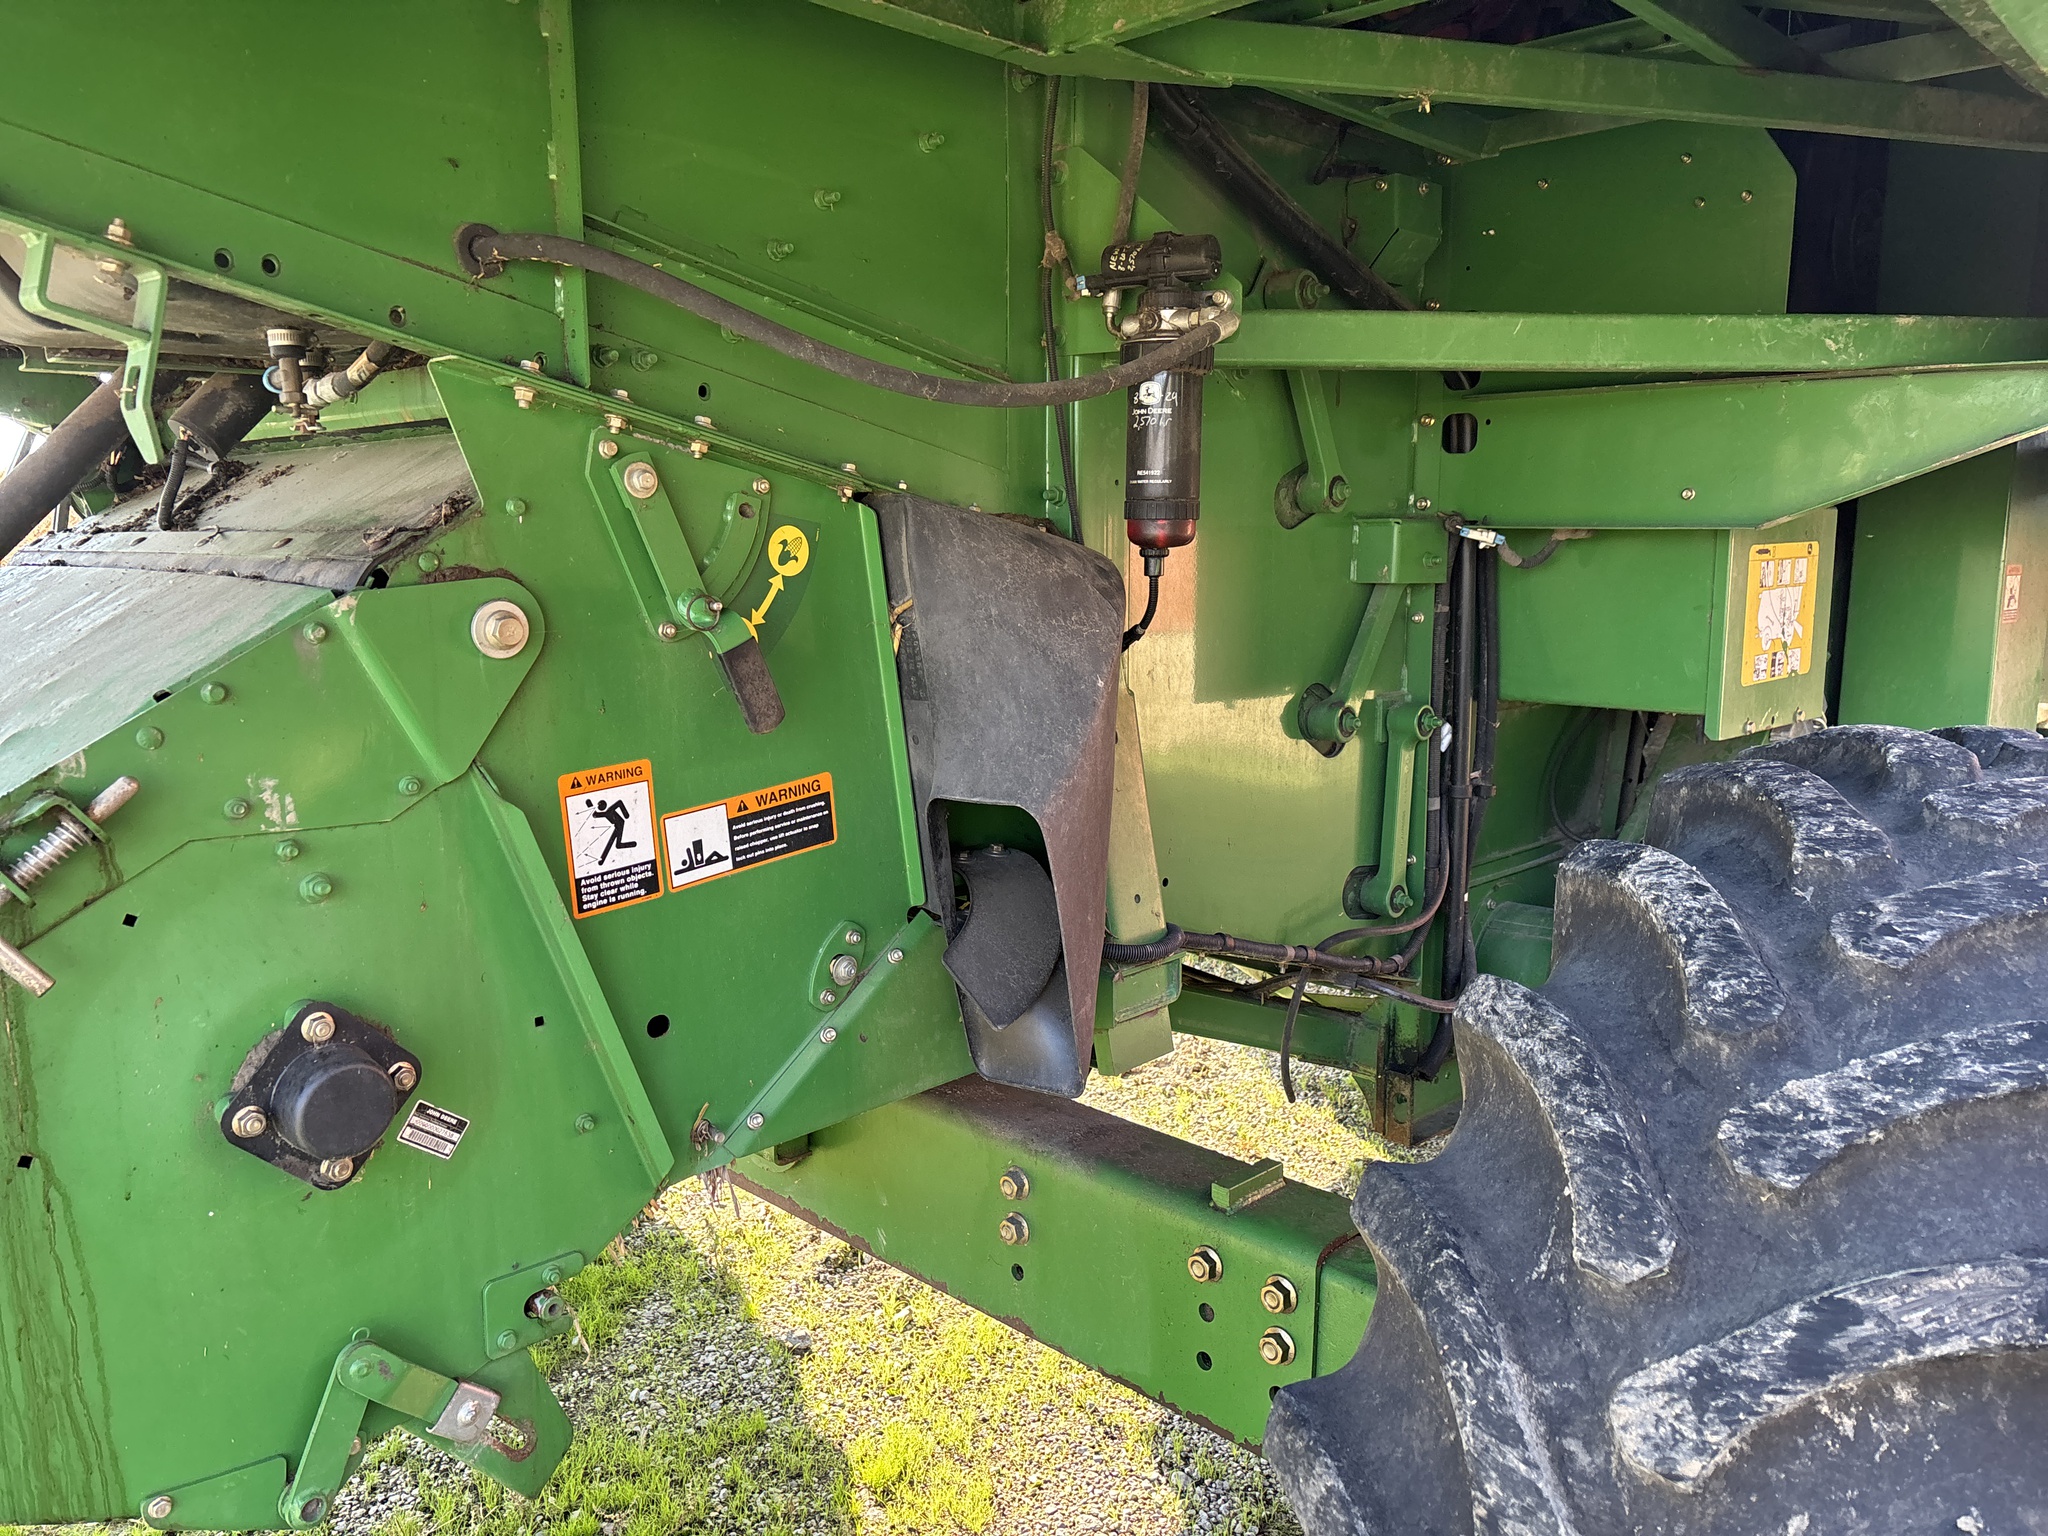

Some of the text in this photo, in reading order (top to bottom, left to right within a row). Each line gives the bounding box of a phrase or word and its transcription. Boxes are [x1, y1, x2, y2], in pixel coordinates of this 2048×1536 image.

[1109, 249, 1120, 270] NEW
[586, 766, 643, 786] WARNING
[755, 780, 821, 807] WARNING
[732, 822, 746, 830] Avoid
[746, 818, 763, 826] serious
[750, 826, 774, 837] performing
[775, 821, 790, 829] service
[581, 863, 652, 886] Avoid serious injury
[581, 871, 654, 894] from thrown objects.
[582, 882, 639, 902] Stay clear while
[583, 899, 608, 910] engine
[618, 888, 647, 900] running.
[440, 1113, 458, 1125] DEERE
